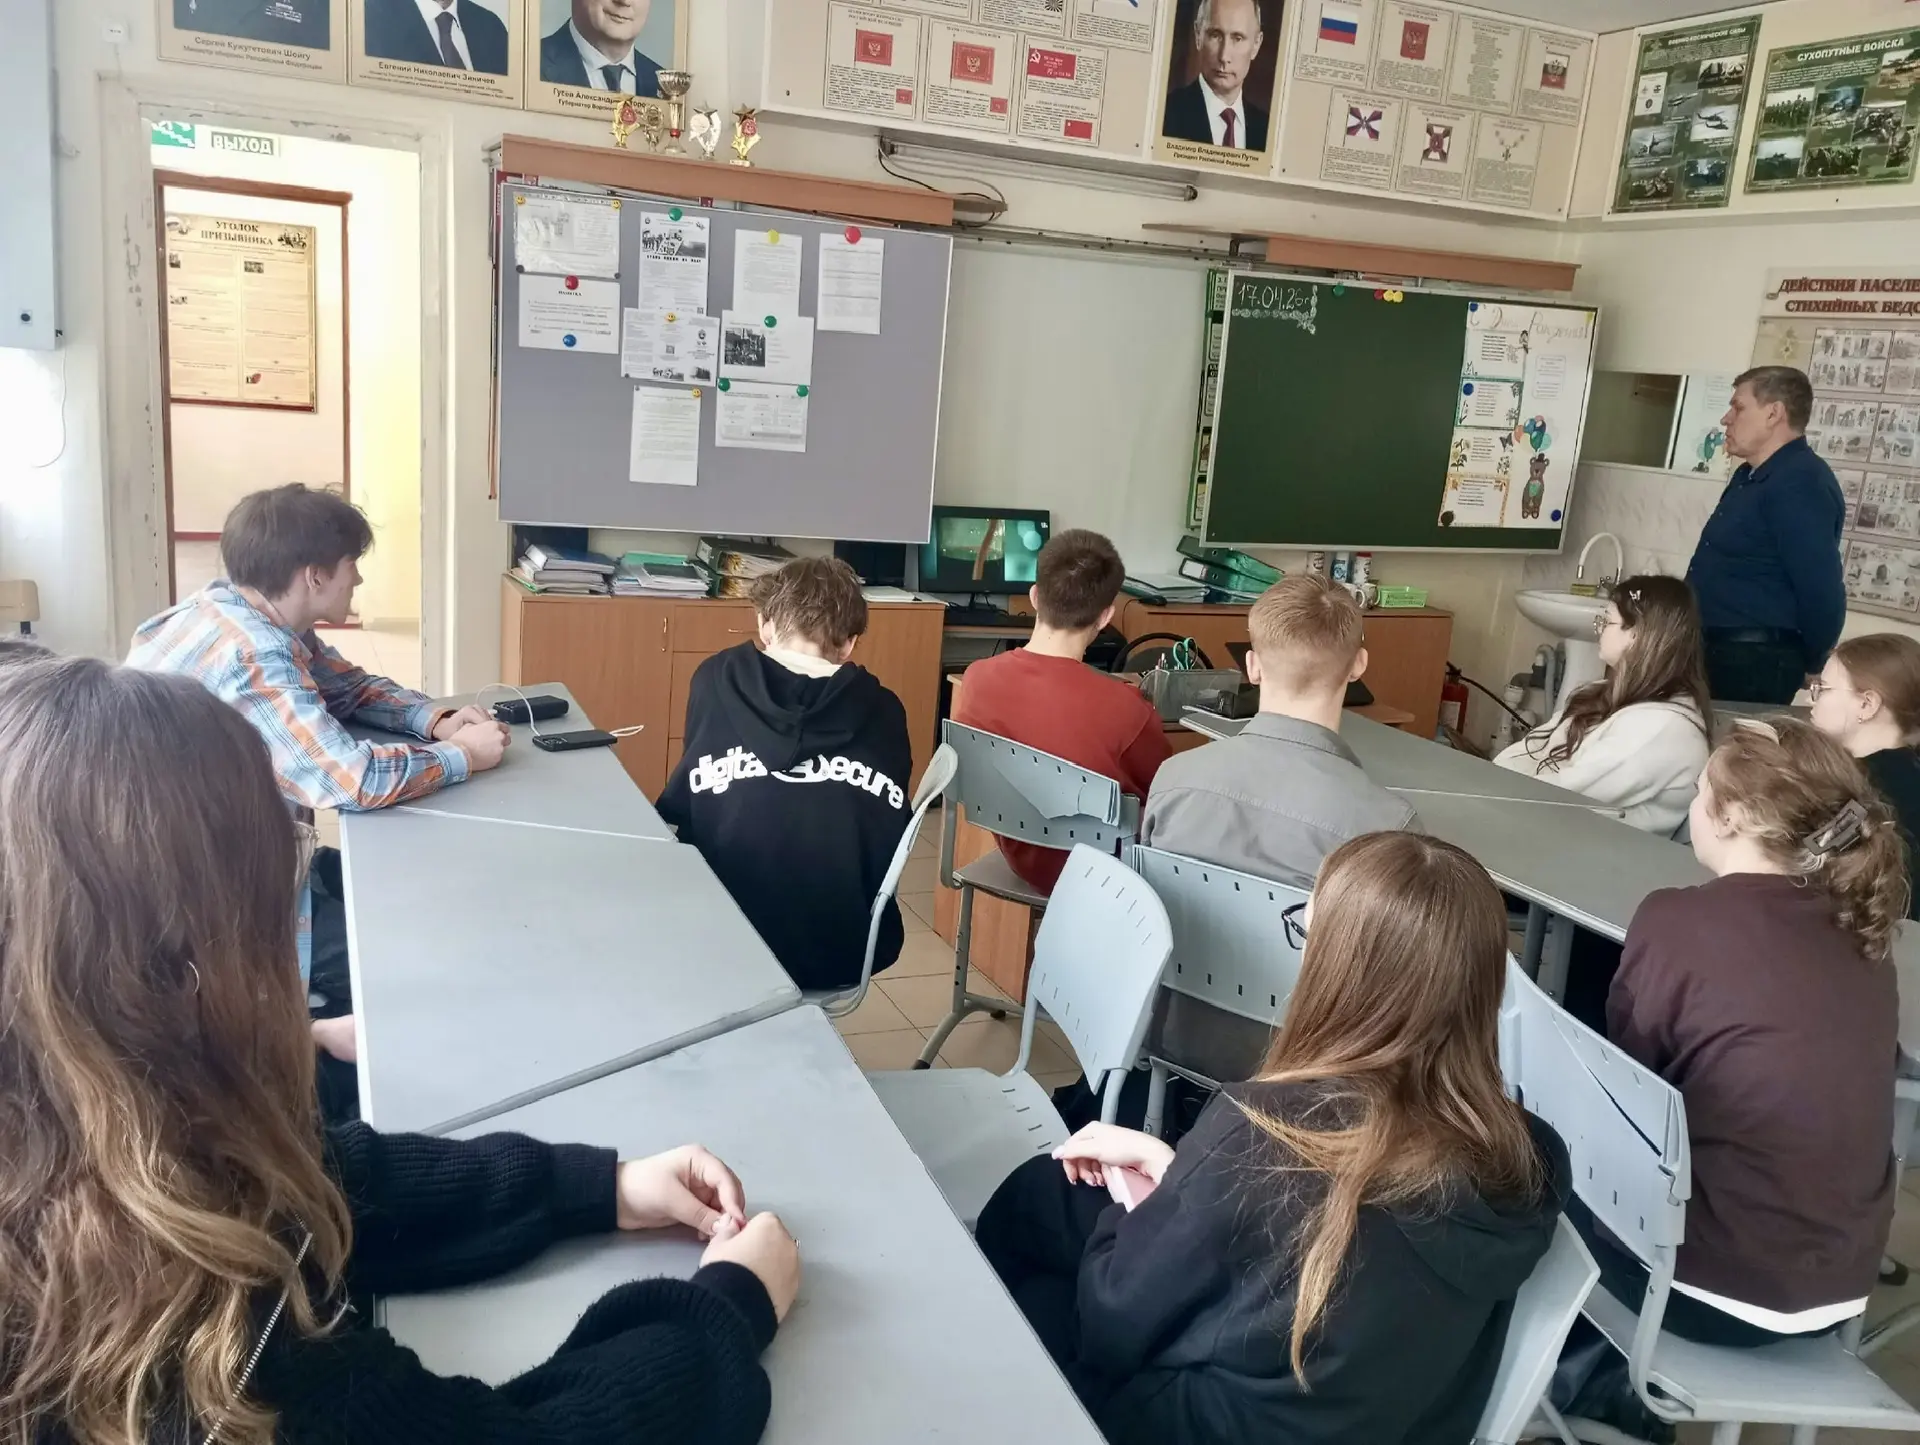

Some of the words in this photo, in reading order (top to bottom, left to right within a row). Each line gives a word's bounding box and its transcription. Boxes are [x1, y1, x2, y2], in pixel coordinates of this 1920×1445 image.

[1797, 44, 1861, 62] СУХОПУТНЫЕ
[1863, 38, 1905, 53] ВОЙСКА
[378, 61, 411, 73] Евгений
[553, 88, 574, 98] Гусев
[212, 134, 273, 155] ВЫХОД
[215, 221, 260, 233] УГОЛОК
[201, 230, 274, 246] ПРИЗЫВНИКА
[1779, 277, 1856, 293] ДЕЙСТВИЯ
[1785, 298, 1878, 313] СТИХИЙНЫХ
